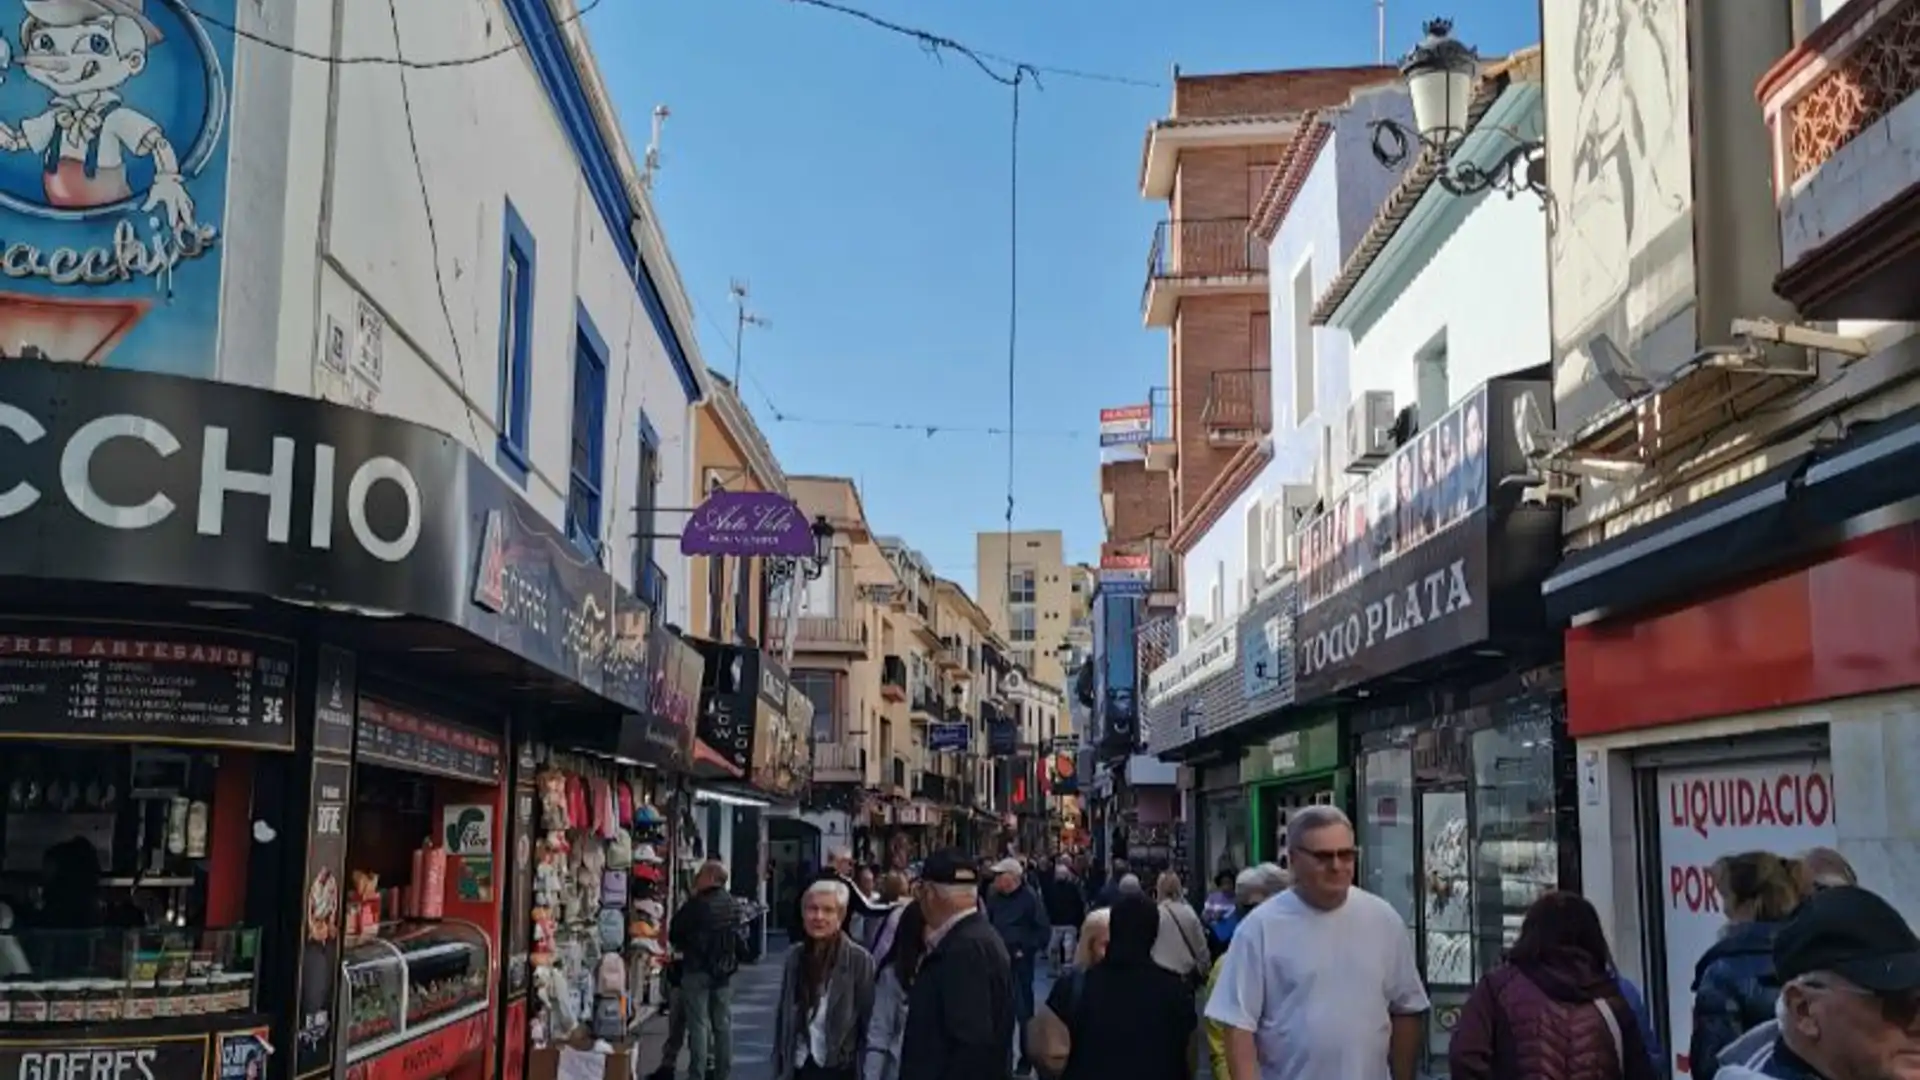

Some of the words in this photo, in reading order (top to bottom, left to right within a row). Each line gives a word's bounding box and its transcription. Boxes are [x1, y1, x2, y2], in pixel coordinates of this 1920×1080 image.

[1365, 557, 1473, 648] PLATA
[88, 639, 254, 664] ARTESANOS
[1671, 772, 1836, 838] LIQUIDACIO
[1671, 865, 1720, 913] POR
